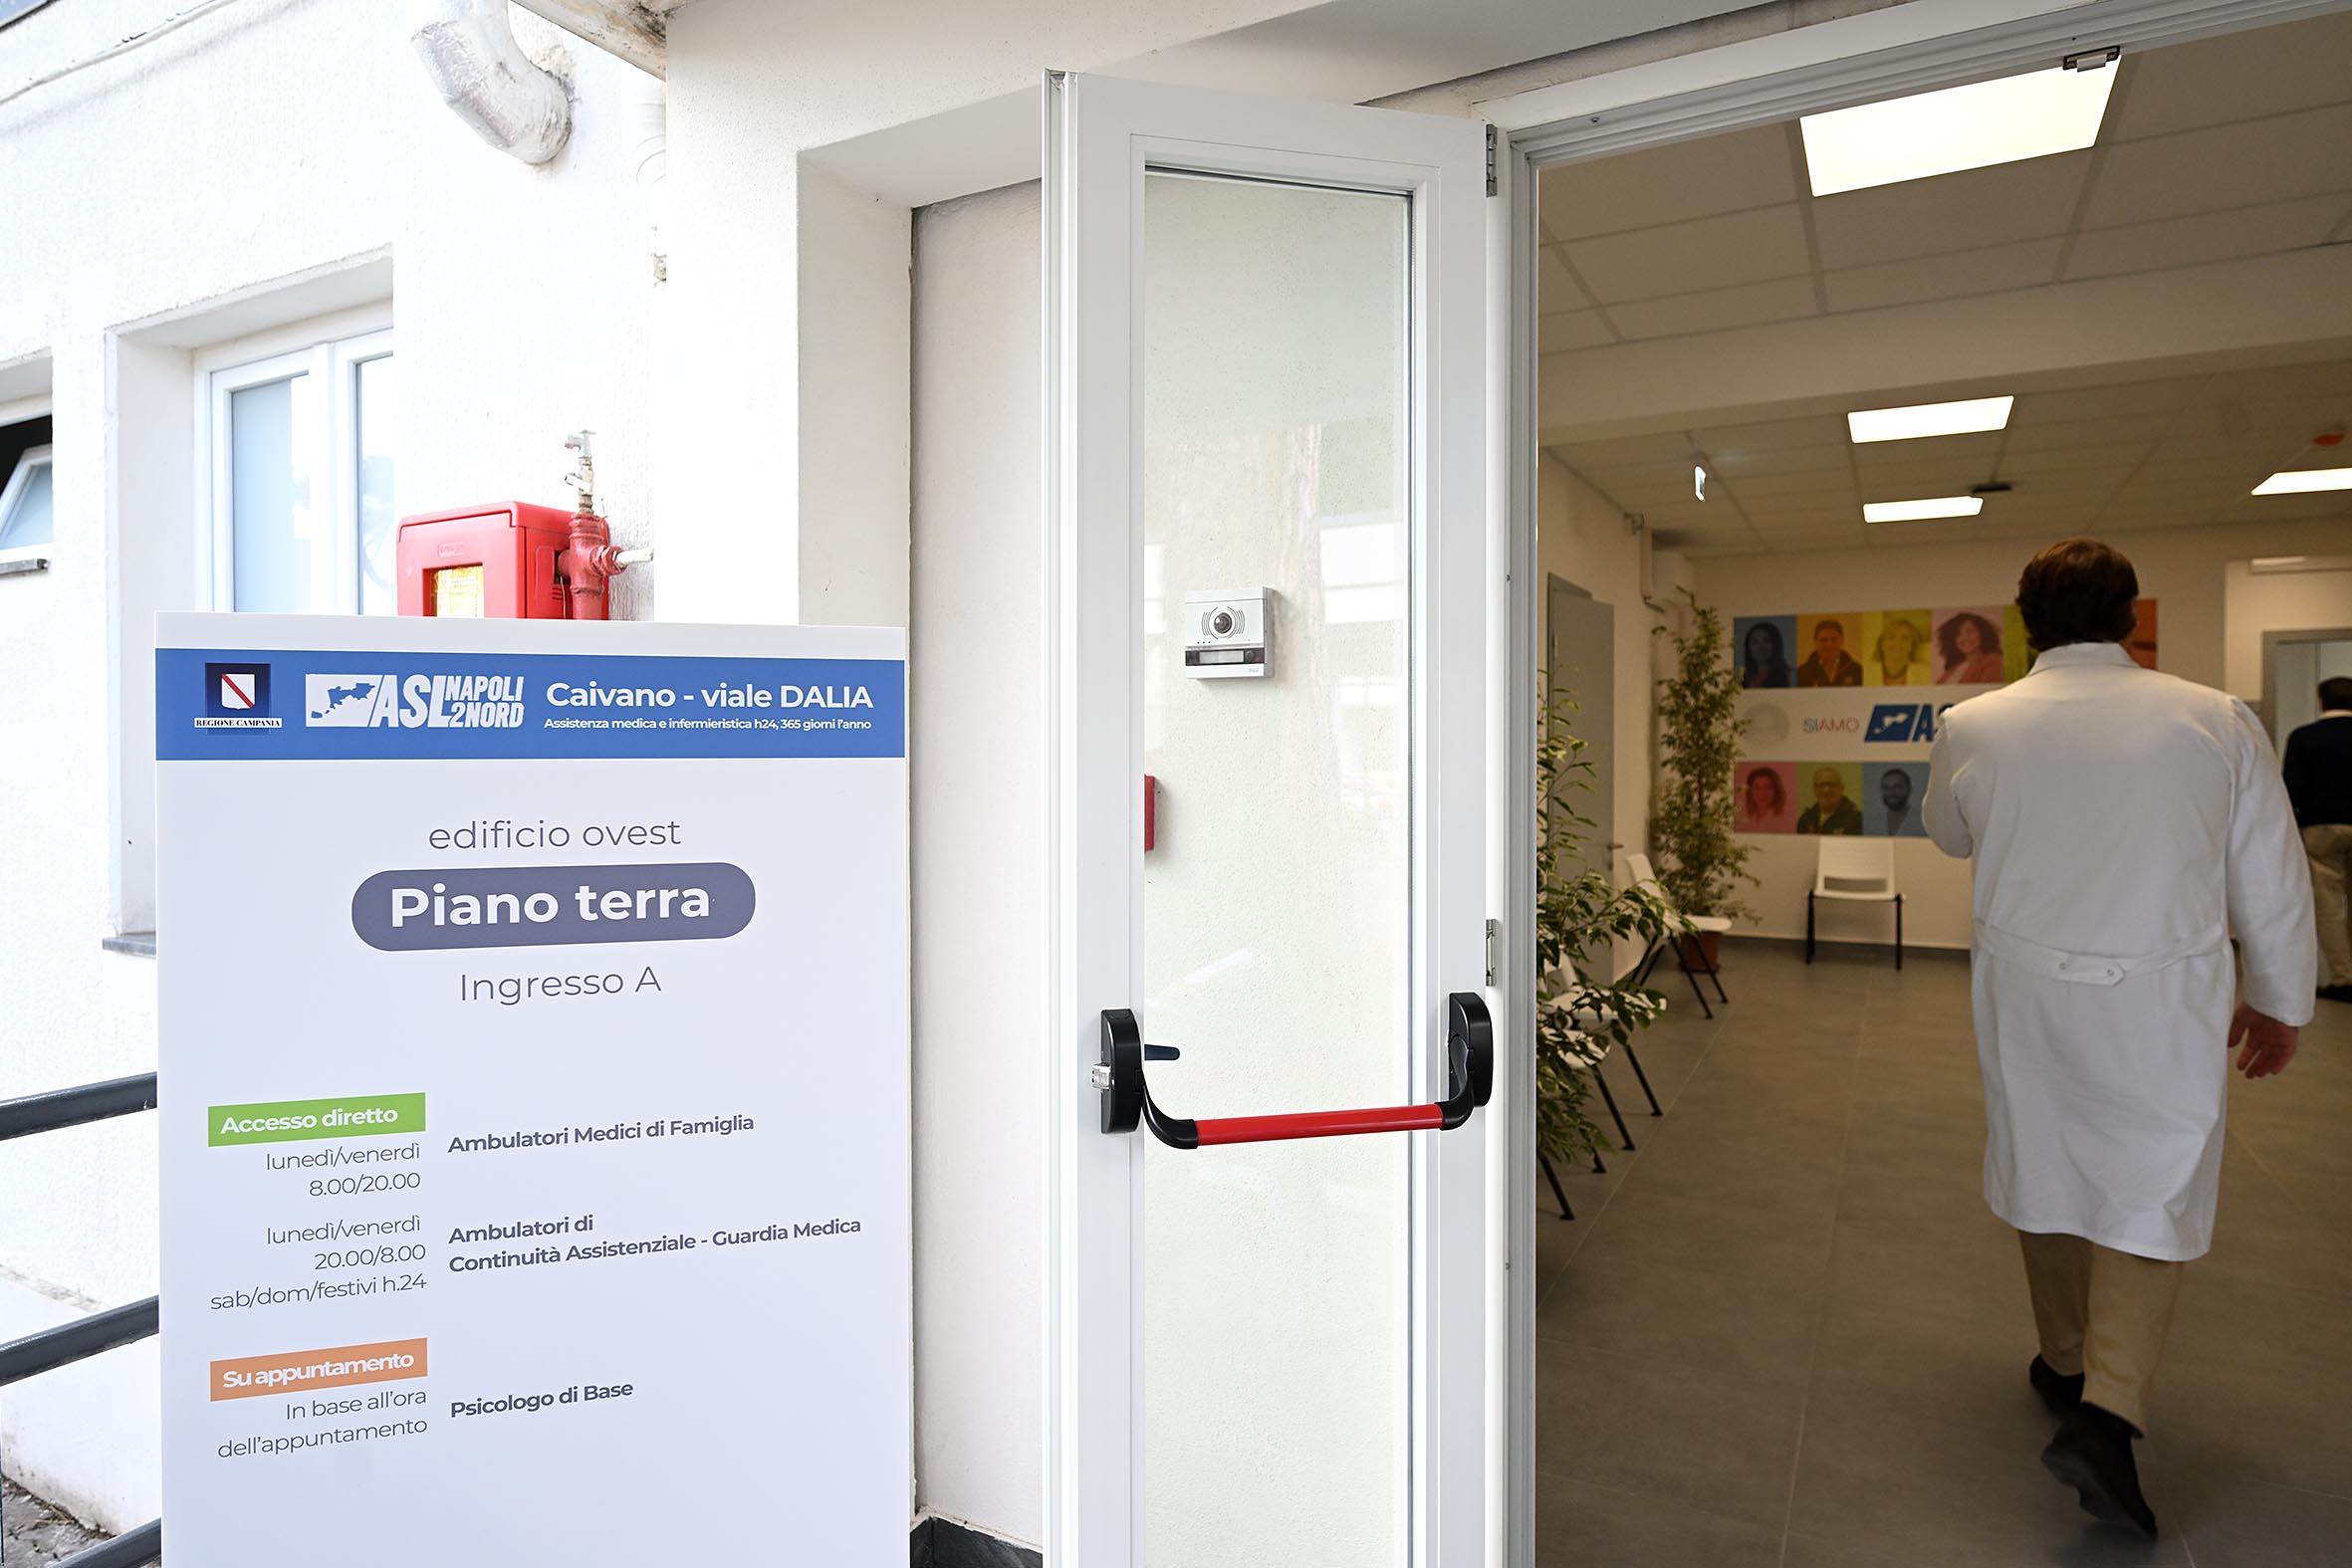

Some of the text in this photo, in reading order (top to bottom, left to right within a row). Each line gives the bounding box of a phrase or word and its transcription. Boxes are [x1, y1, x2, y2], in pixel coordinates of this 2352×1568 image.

[370, 675, 447, 728] ASL
[445, 676, 524, 701] NAPOLI
[547, 680, 676, 707] Caivano
[701, 682, 773, 707] viale
[780, 686, 873, 708] DALIA
[449, 702, 524, 728] 2NORD
[544, 718, 609, 728] Assistenza
[612, 718, 656, 728] medica
[668, 718, 752, 730] infermieristica
[755, 719, 779, 730] h24,
[781, 720, 801, 729] 365
[803, 719, 835, 731] giorni
[1802, 704, 1955, 743] SIAMO A
[428, 820, 681, 849] edificio ovest
[391, 883, 710, 927] Piano terra
[461, 967, 662, 1006] Ingresso A
[220, 1108, 398, 1134] Accesso diretto
[448, 1115, 754, 1153] Ambulatori Medici di Famiglia
[267, 1143, 420, 1171] lunedì/venerdì
[310, 1172, 421, 1197] 8.00/20.00
[267, 1216, 420, 1244] lunedì/venerdì
[448, 1215, 593, 1243] Ambulatori di
[314, 1244, 426, 1269] 20.00/8.00
[449, 1246, 561, 1272] Continuità
[567, 1234, 696, 1261] Assistenziale
[712, 1227, 788, 1245] Guardia
[793, 1219, 861, 1238] Medica
[210, 1273, 426, 1309] sab/dom/festivi h.24
[223, 1353, 414, 1389] Su appuntamento
[287, 1403, 306, 1420] In
[312, 1397, 361, 1417] base
[450, 1382, 633, 1419] Psicologo di Base
